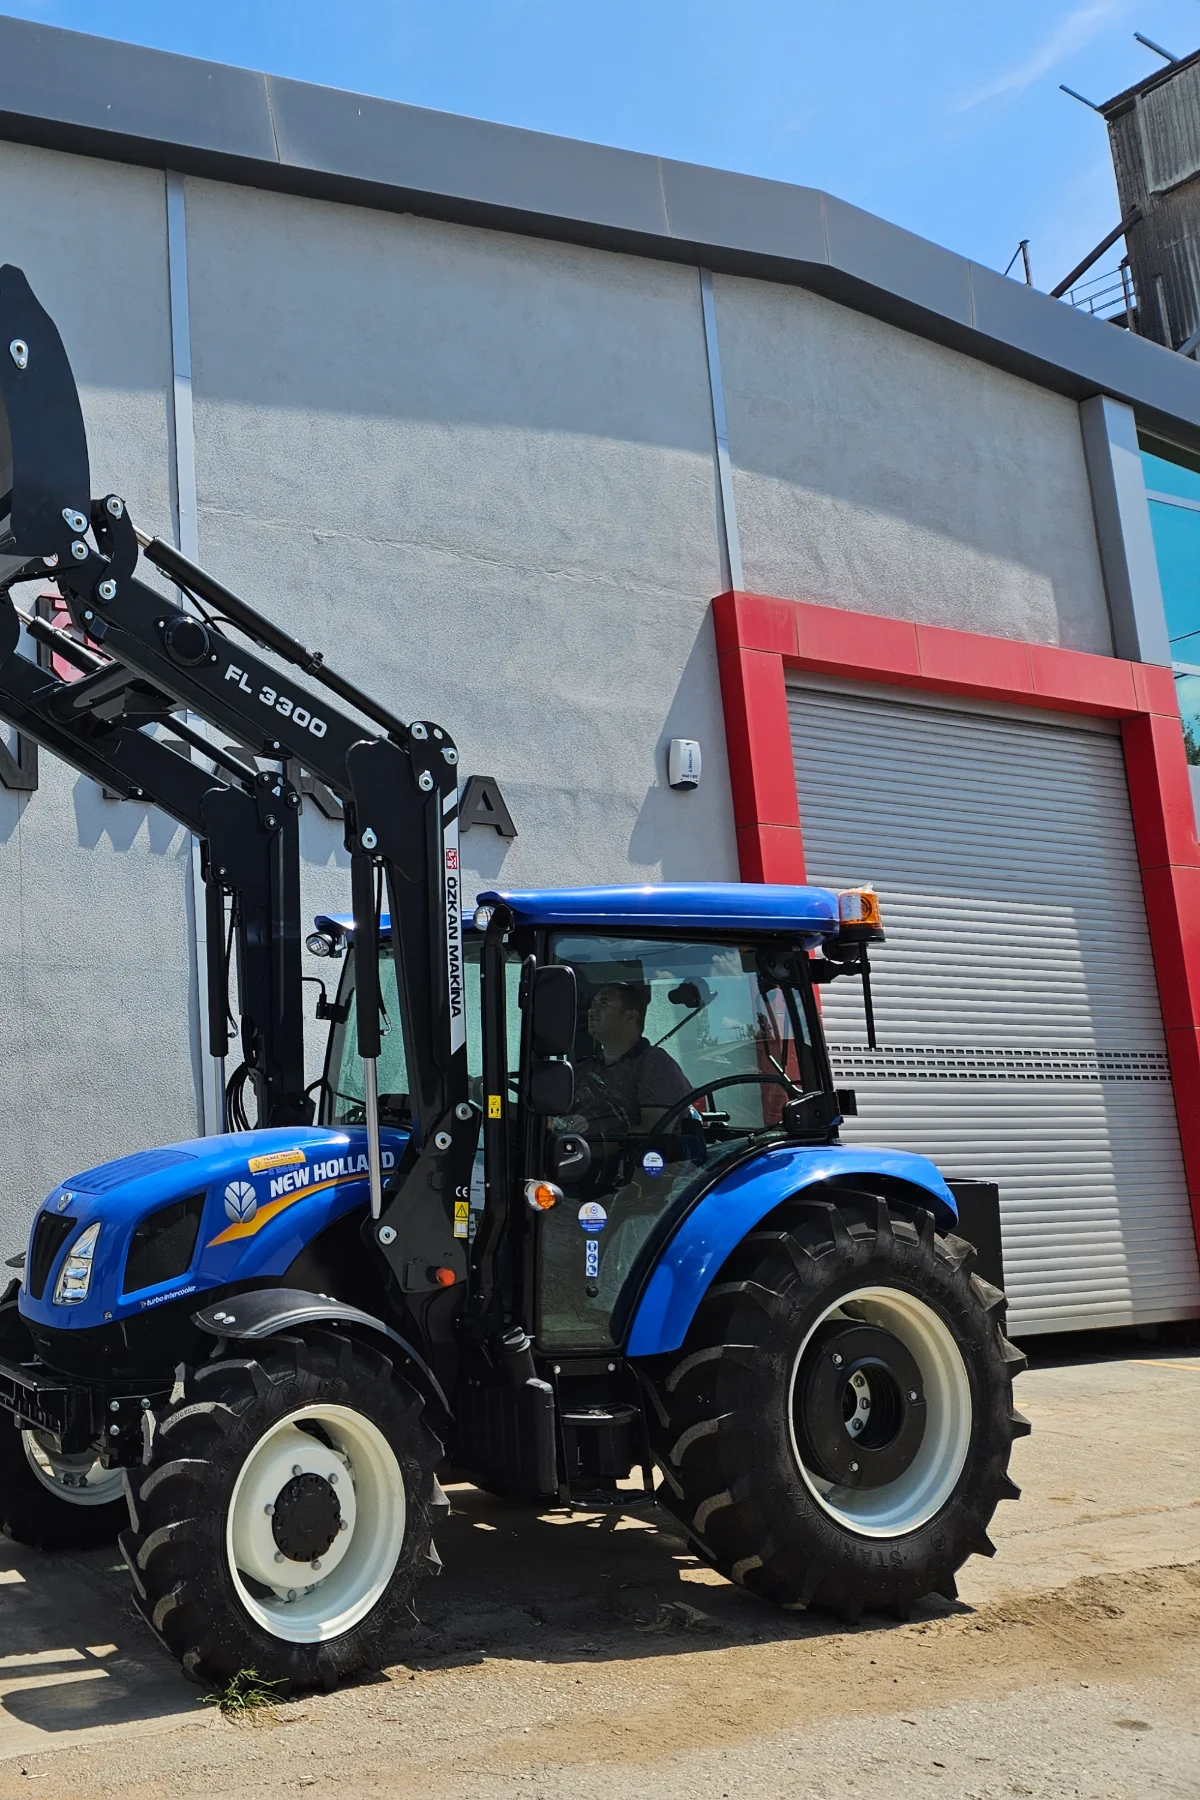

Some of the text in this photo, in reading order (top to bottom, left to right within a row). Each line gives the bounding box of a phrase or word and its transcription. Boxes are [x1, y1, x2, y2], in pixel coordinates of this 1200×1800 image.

[224, 663, 328, 739] FL 3300
[446, 876, 462, 1018] ÖZKAN MAKİNA
[270, 1151, 395, 1198] NEW HOLLAD
[455, 1186, 469, 1198] CE
